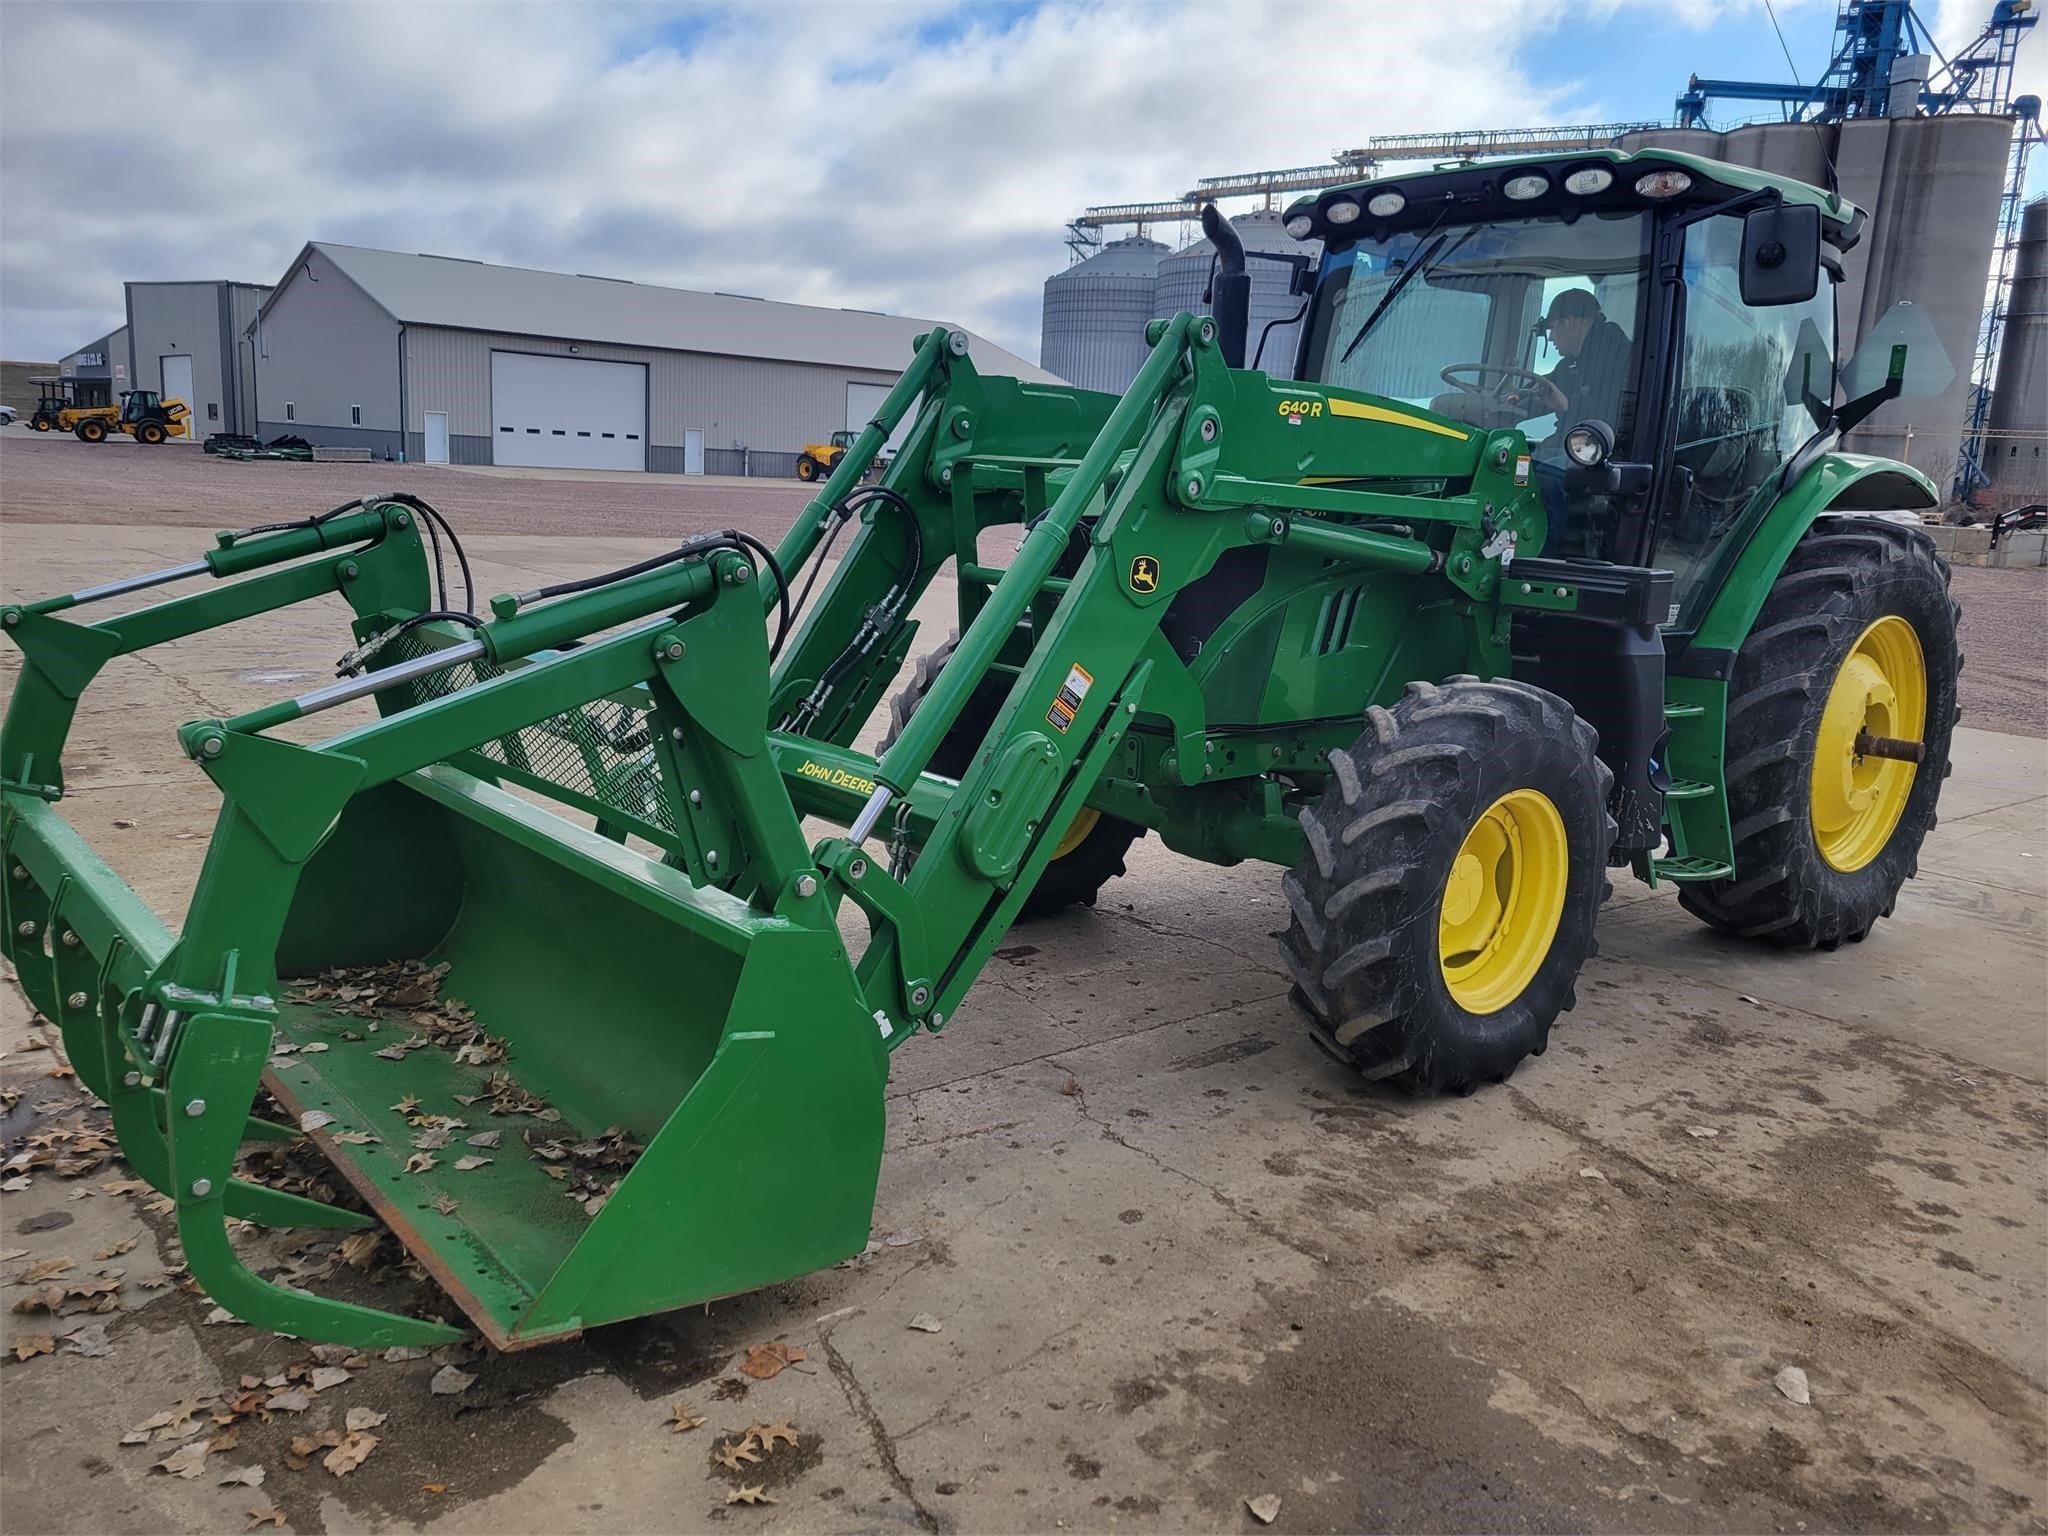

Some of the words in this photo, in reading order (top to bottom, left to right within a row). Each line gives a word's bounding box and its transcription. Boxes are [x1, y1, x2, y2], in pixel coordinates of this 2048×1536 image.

[167, 404, 183, 416] JCB
[1278, 400, 1322, 417] 640R
[797, 760, 833, 780] JOHN
[831, 770, 876, 794] DEERE
